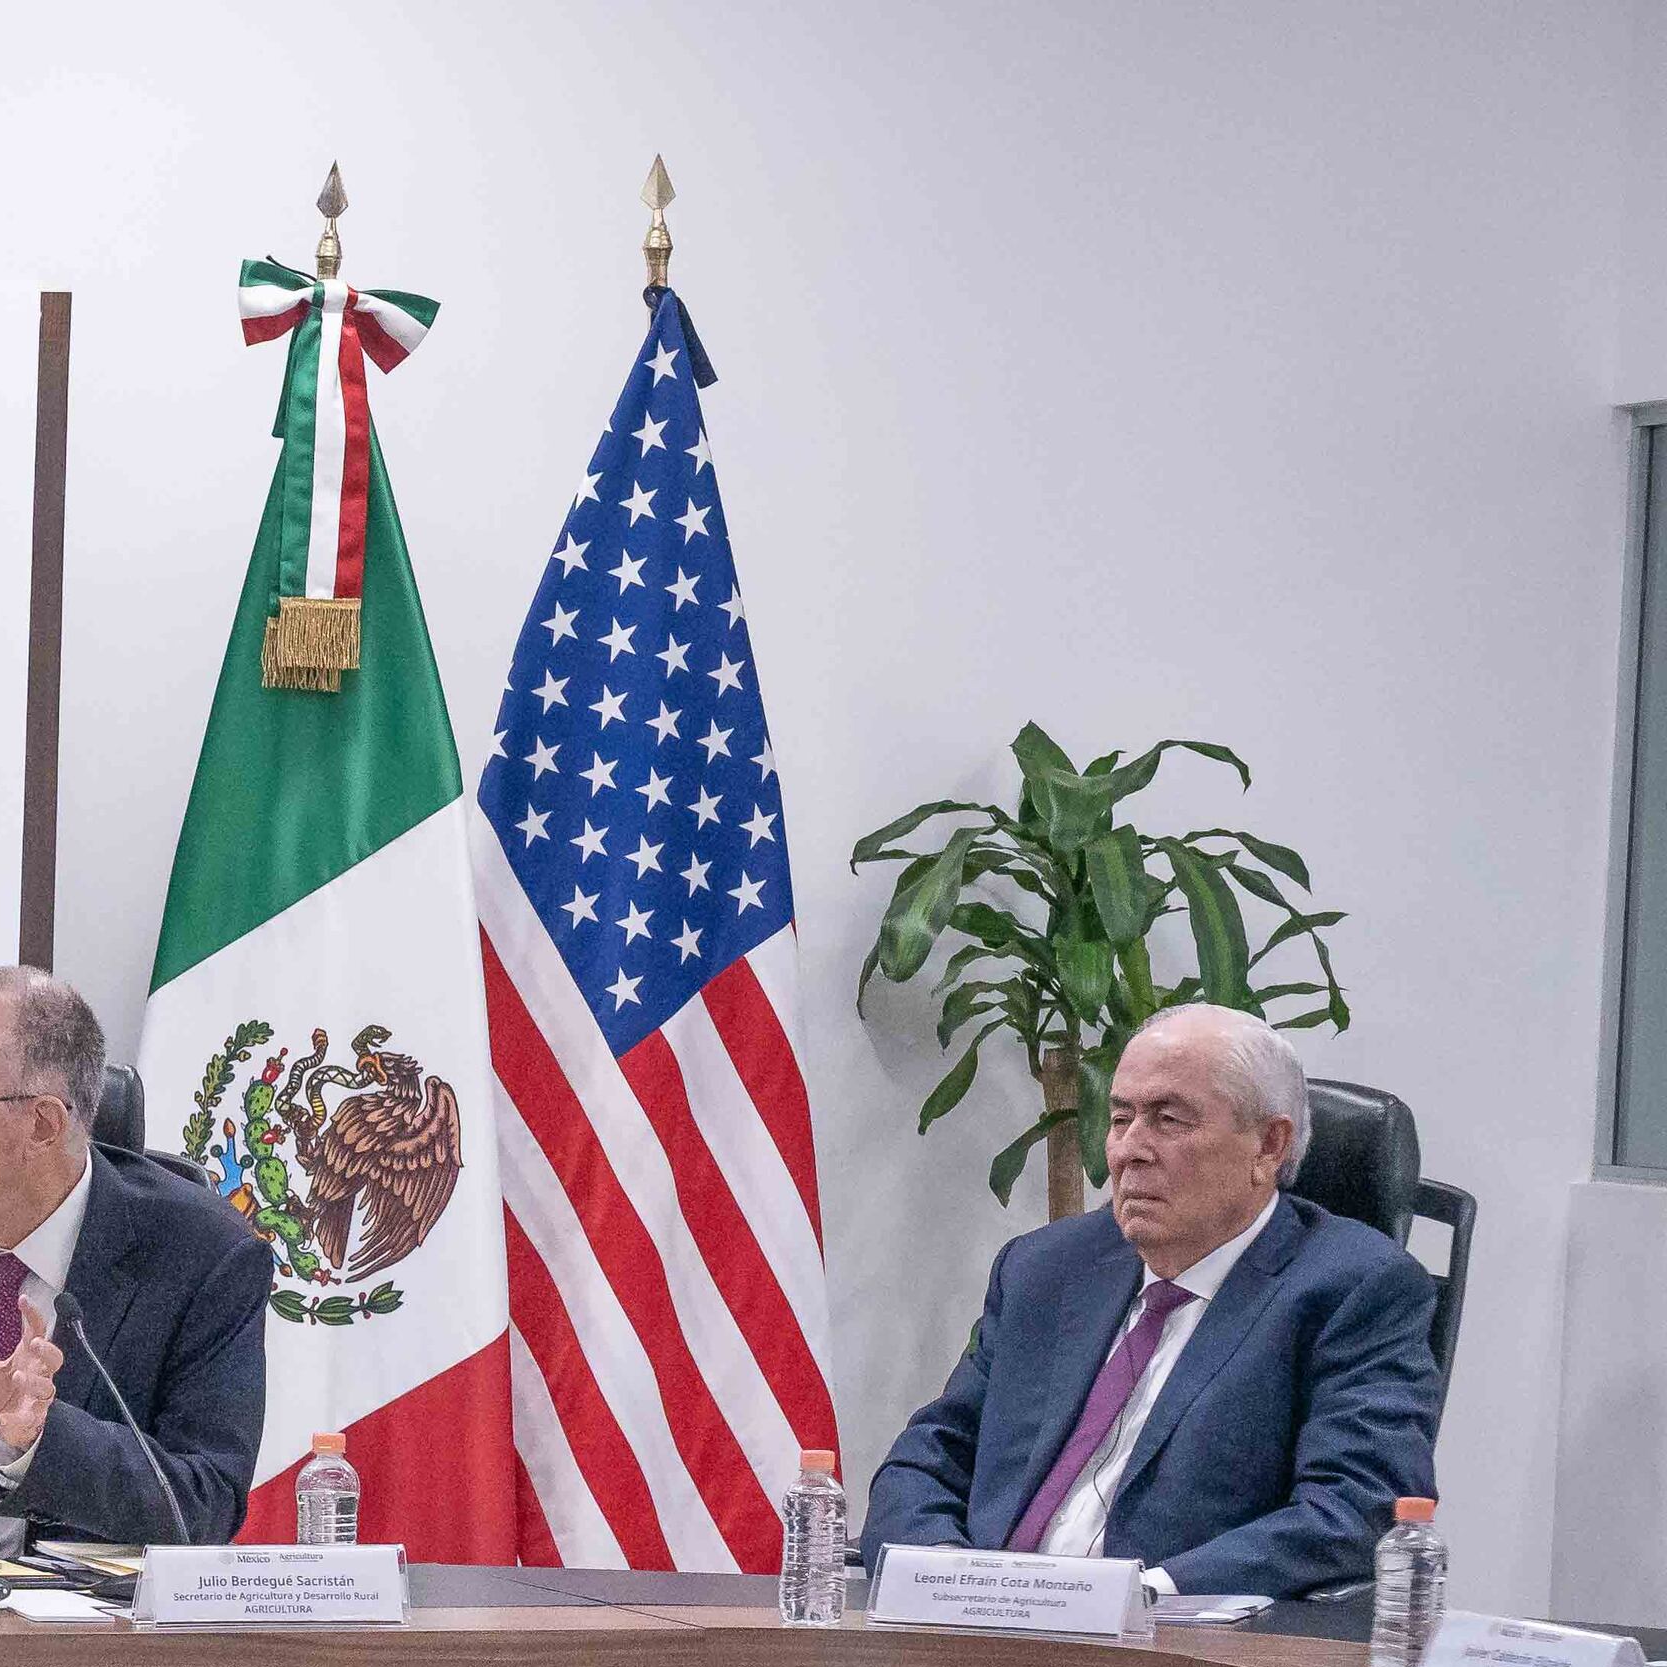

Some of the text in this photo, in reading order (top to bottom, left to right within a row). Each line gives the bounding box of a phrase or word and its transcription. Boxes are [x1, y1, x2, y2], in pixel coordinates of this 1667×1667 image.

[197, 1575, 355, 1590] Julio Berdegué Sacristán
[914, 1572, 1093, 1592] Leonel Efraín Cota Montaño
[173, 1592, 224, 1602] Secretario
[225, 1592, 238, 1602] de
[239, 1592, 294, 1604] Agricultura
[303, 1592, 352, 1602] Desarrollo
[353, 1592, 379, 1602] Rural
[1012, 1596, 1067, 1608] Agricultura
[244, 1604, 313, 1614] AGRICULTURA
[961, 1606, 1031, 1619] AGRICULTURA
